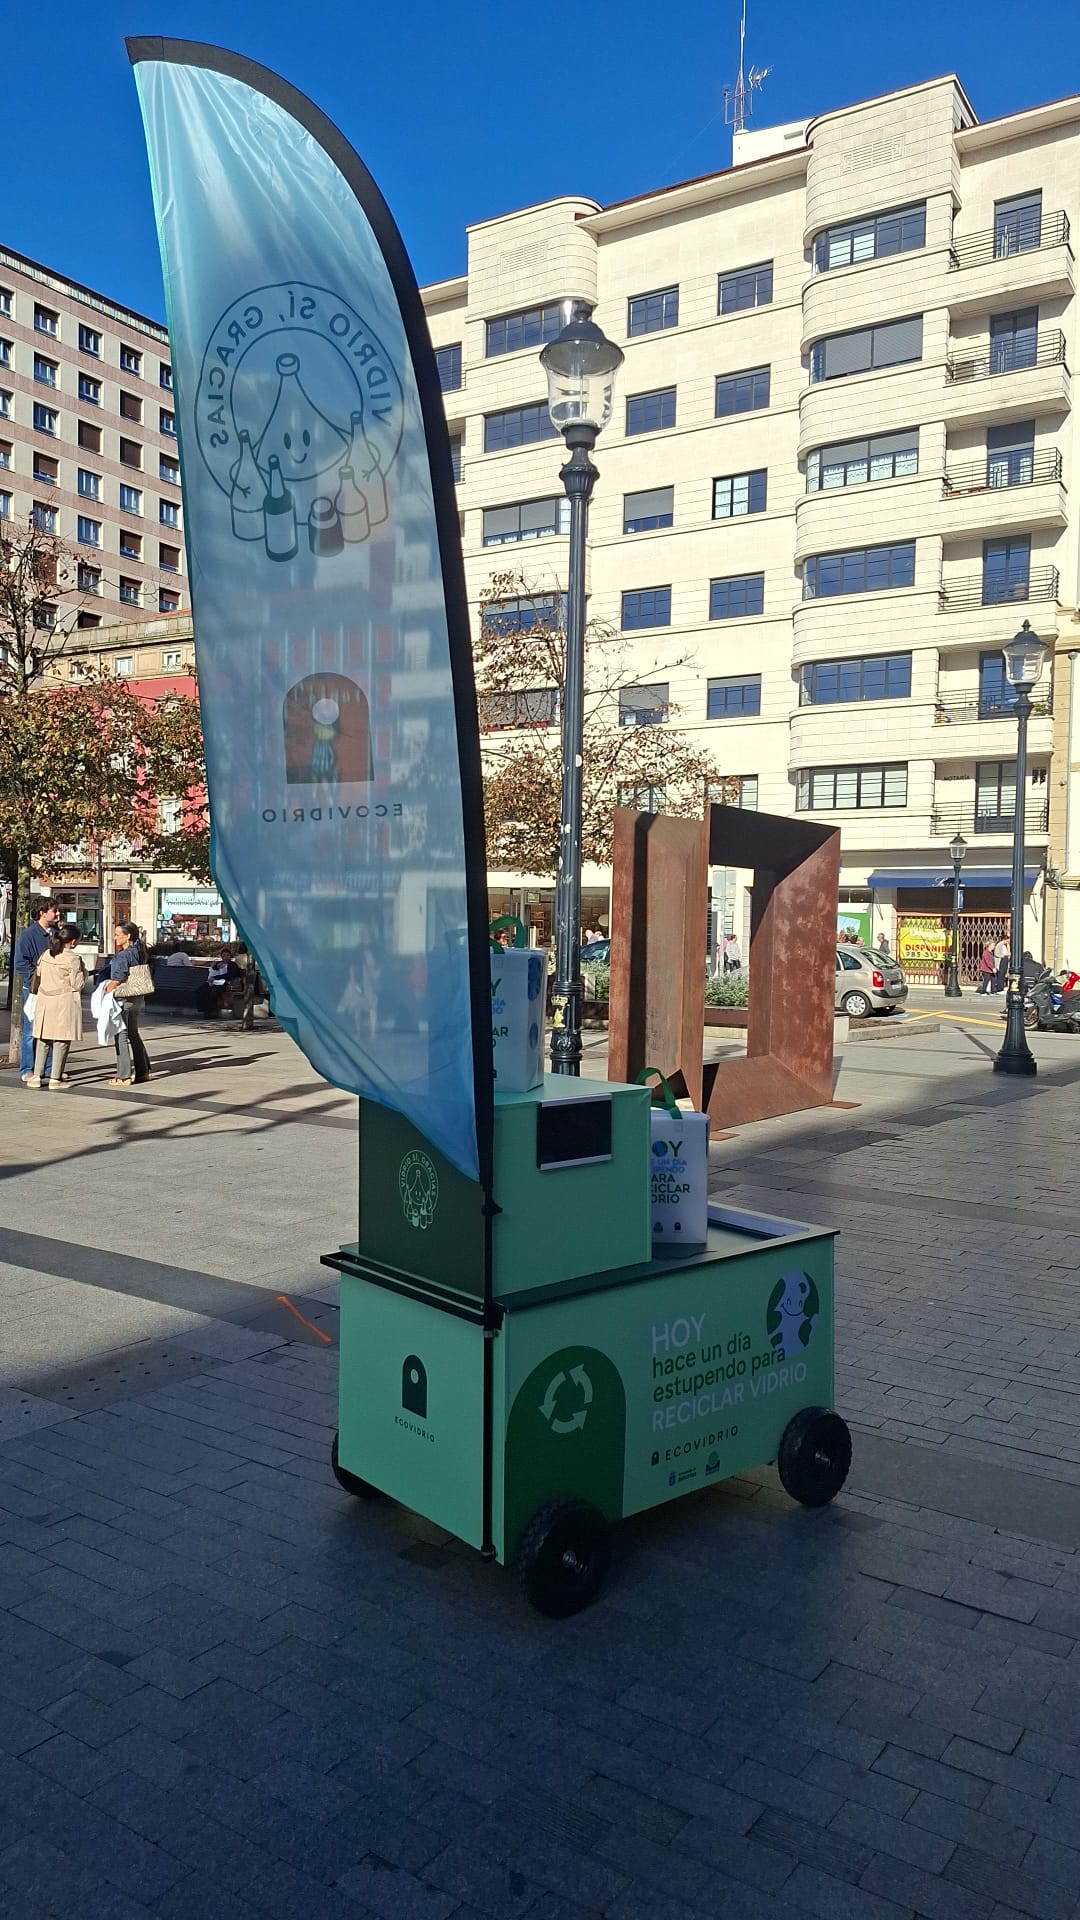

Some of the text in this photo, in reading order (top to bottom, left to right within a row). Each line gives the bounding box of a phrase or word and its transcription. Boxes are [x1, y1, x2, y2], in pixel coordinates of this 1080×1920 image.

[651, 1140, 683, 1157] OY
[651, 1173, 676, 1183] ARA
[652, 1183, 691, 1193] ICLAR
[651, 1194, 680, 1204] DRIO
[652, 1313, 706, 1353] HOY
[652, 1332, 751, 1378] hace un día
[653, 1347, 786, 1402] estupendo para
[652, 1362, 807, 1432] RECICLAR VIDRIO
[394, 1415, 435, 1443] ECOVIDRIO
[665, 1425, 739, 1461] ECOVIDRIO
